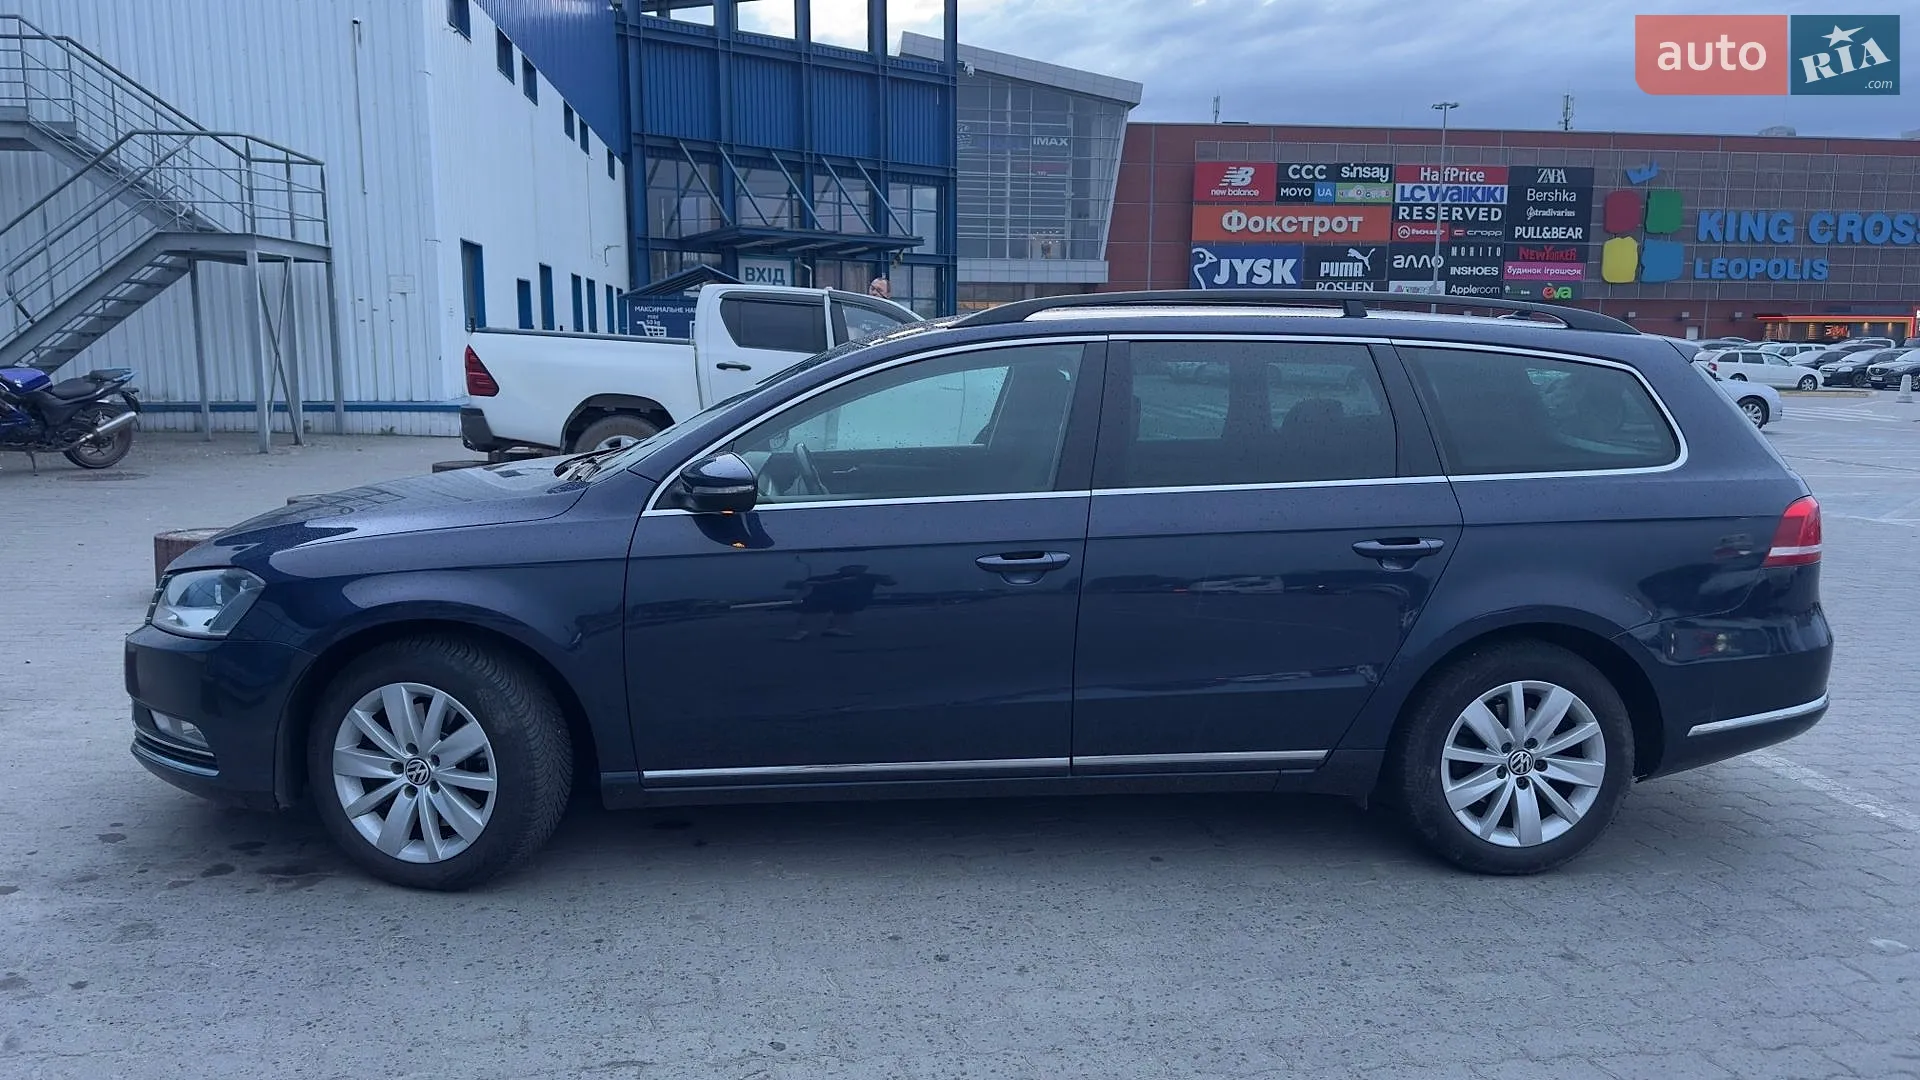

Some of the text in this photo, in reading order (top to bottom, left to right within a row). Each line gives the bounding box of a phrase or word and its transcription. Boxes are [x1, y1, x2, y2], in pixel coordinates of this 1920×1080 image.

[1033, 137, 1068, 146] IMAX
[1288, 164, 1327, 180] CCC
[1340, 163, 1390, 183] sinsay
[1420, 167, 1485, 182] HafPrice
[1536, 168, 1568, 184] ZARA
[1228, 188, 1260, 196] balance
[1280, 187, 1312, 197] MOYO
[1318, 187, 1333, 197] UA
[1527, 188, 1577, 202] Bershka
[1398, 206, 1503, 221] RESERVED
[1221, 209, 1364, 237] Фокстрот
[1697, 211, 1920, 244] KING CROS
[1467, 229, 1502, 237] cropp
[1514, 226, 1583, 240] PULL&BEAR
[745, 266, 786, 284] ВХІД
[1213, 258, 1298, 285] JYSK
[1320, 262, 1364, 277] PUMA
[1450, 266, 1499, 275] INSHOES
[1507, 266, 1542, 276] будинок
[1694, 258, 1830, 280] LEOPOLIS
[1315, 281, 1375, 292] ROSHEN
[1450, 284, 1500, 295] Appleroom
[634, 305, 684, 313] МАКСИМАЛЬНЕ
